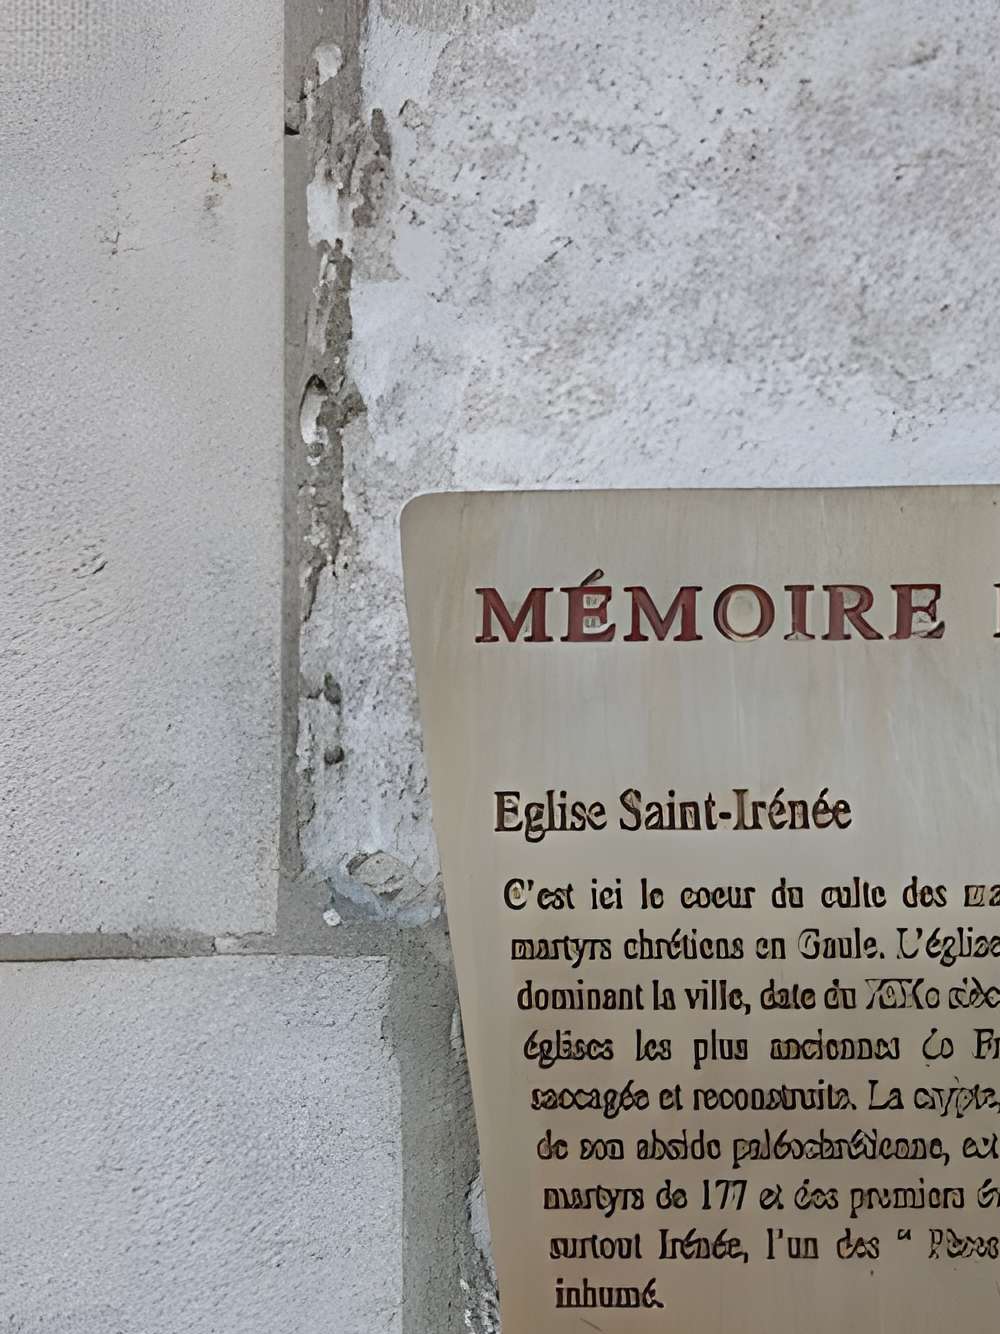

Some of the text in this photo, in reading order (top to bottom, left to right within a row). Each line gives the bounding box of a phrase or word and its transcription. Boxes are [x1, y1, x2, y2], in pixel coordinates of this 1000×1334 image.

[473, 567, 946, 644] MÉMOIRE
[492, 785, 853, 844] Eglise Saint-Irénée
[502, 876, 576, 911] C'est
[589, 876, 624, 910] ici
[639, 876, 665, 910] le
[679, 884, 757, 910] coeur
[770, 875, 805, 909] du
[819, 874, 888, 909] culte
[901, 874, 948, 909] des
[509, 934, 612, 969] martyrs
[622, 926, 745, 961] chrétiens
[754, 936, 787, 960] en
[796, 925, 886, 960] Gaule.
[515, 977, 645, 1012] dominant
[650, 978, 677, 1011] la
[682, 977, 752, 1016] ville,
[758, 976, 817, 1011] date
[822, 977, 857, 1010] du
[634, 1027, 672, 1062] les
[692, 1027, 749, 1069] plus
[657, 1082, 684, 1112] et
[866, 1078, 905, 1111] La
[535, 1127, 569, 1161] de
[578, 1137, 625, 1161] son
[635, 1127, 722, 1161] abside
[542, 1183, 645, 1219] martyrs
[654, 1177, 689, 1210] de
[700, 1177, 748, 1211] 177
[757, 1182, 785, 1211] et
[848, 1176, 965, 1218] premiers
[548, 1231, 643, 1260] surtout
[657, 1226, 749, 1264] Irénée,
[765, 1226, 820, 1260] l'un
[835, 1226, 880, 1260] des
